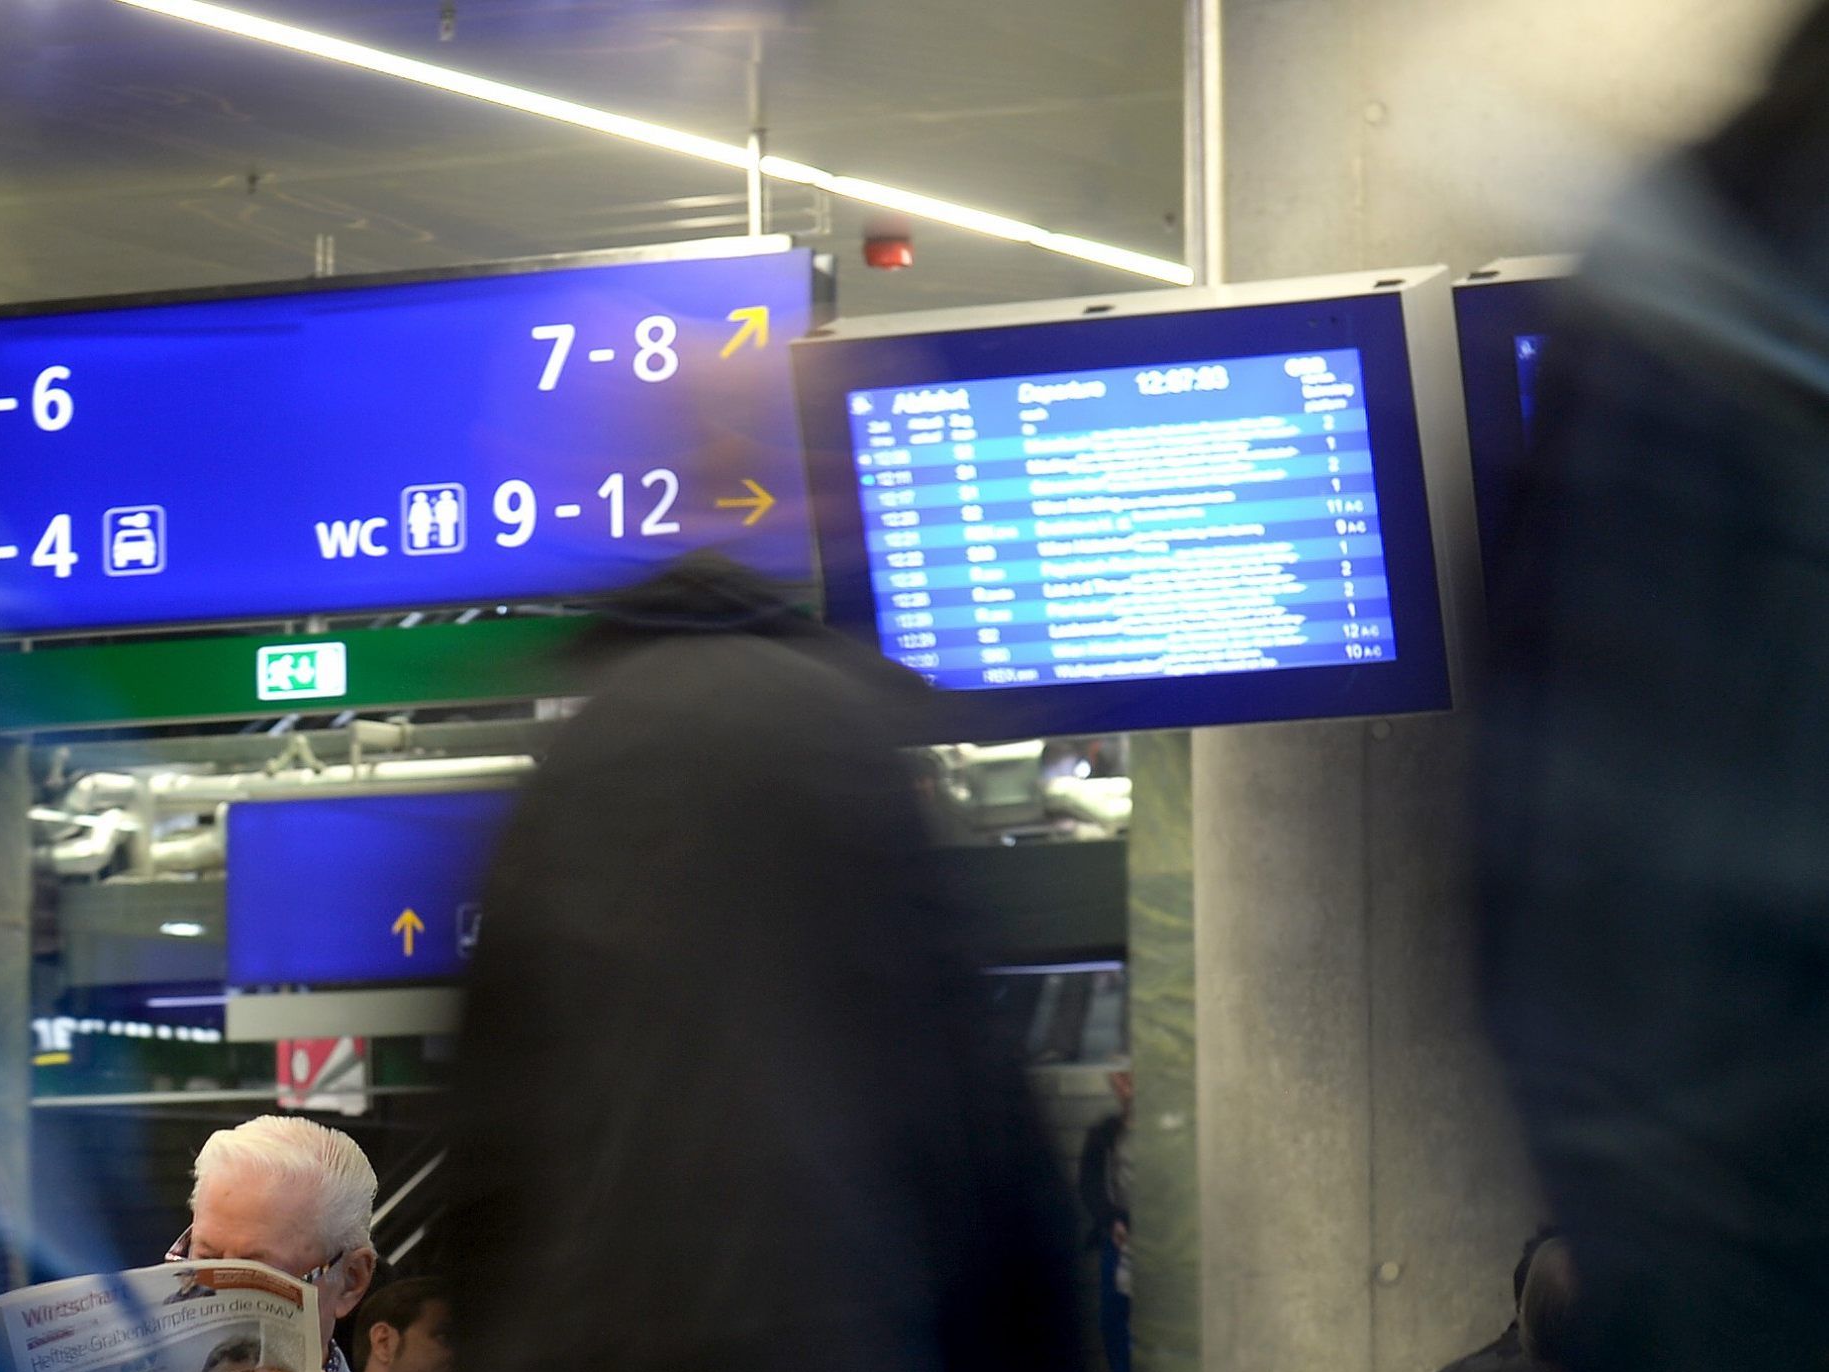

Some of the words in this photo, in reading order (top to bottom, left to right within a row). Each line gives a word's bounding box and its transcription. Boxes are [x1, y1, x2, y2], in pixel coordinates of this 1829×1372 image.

[315, 516, 389, 560] WC
[200, 1304, 226, 1317] um
[228, 1299, 253, 1312] die
